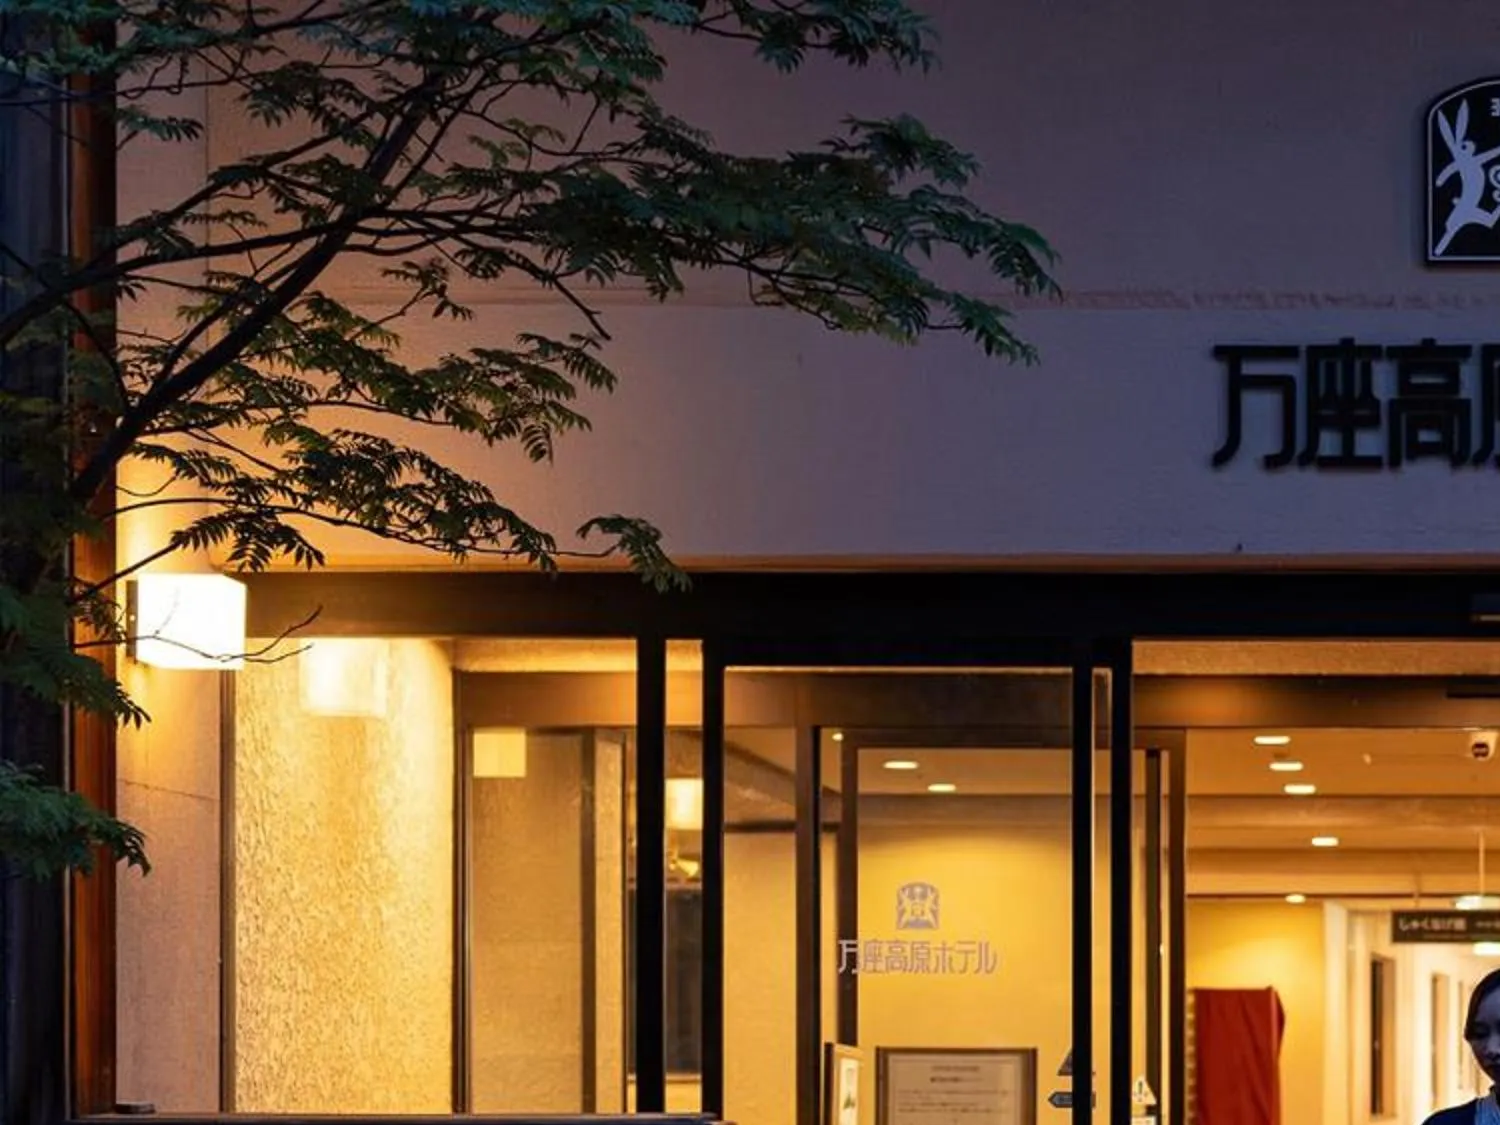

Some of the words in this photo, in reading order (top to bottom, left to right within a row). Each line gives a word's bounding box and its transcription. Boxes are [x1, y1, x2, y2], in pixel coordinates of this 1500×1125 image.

[838, 940, 998, 975] 万座高原ホテル
